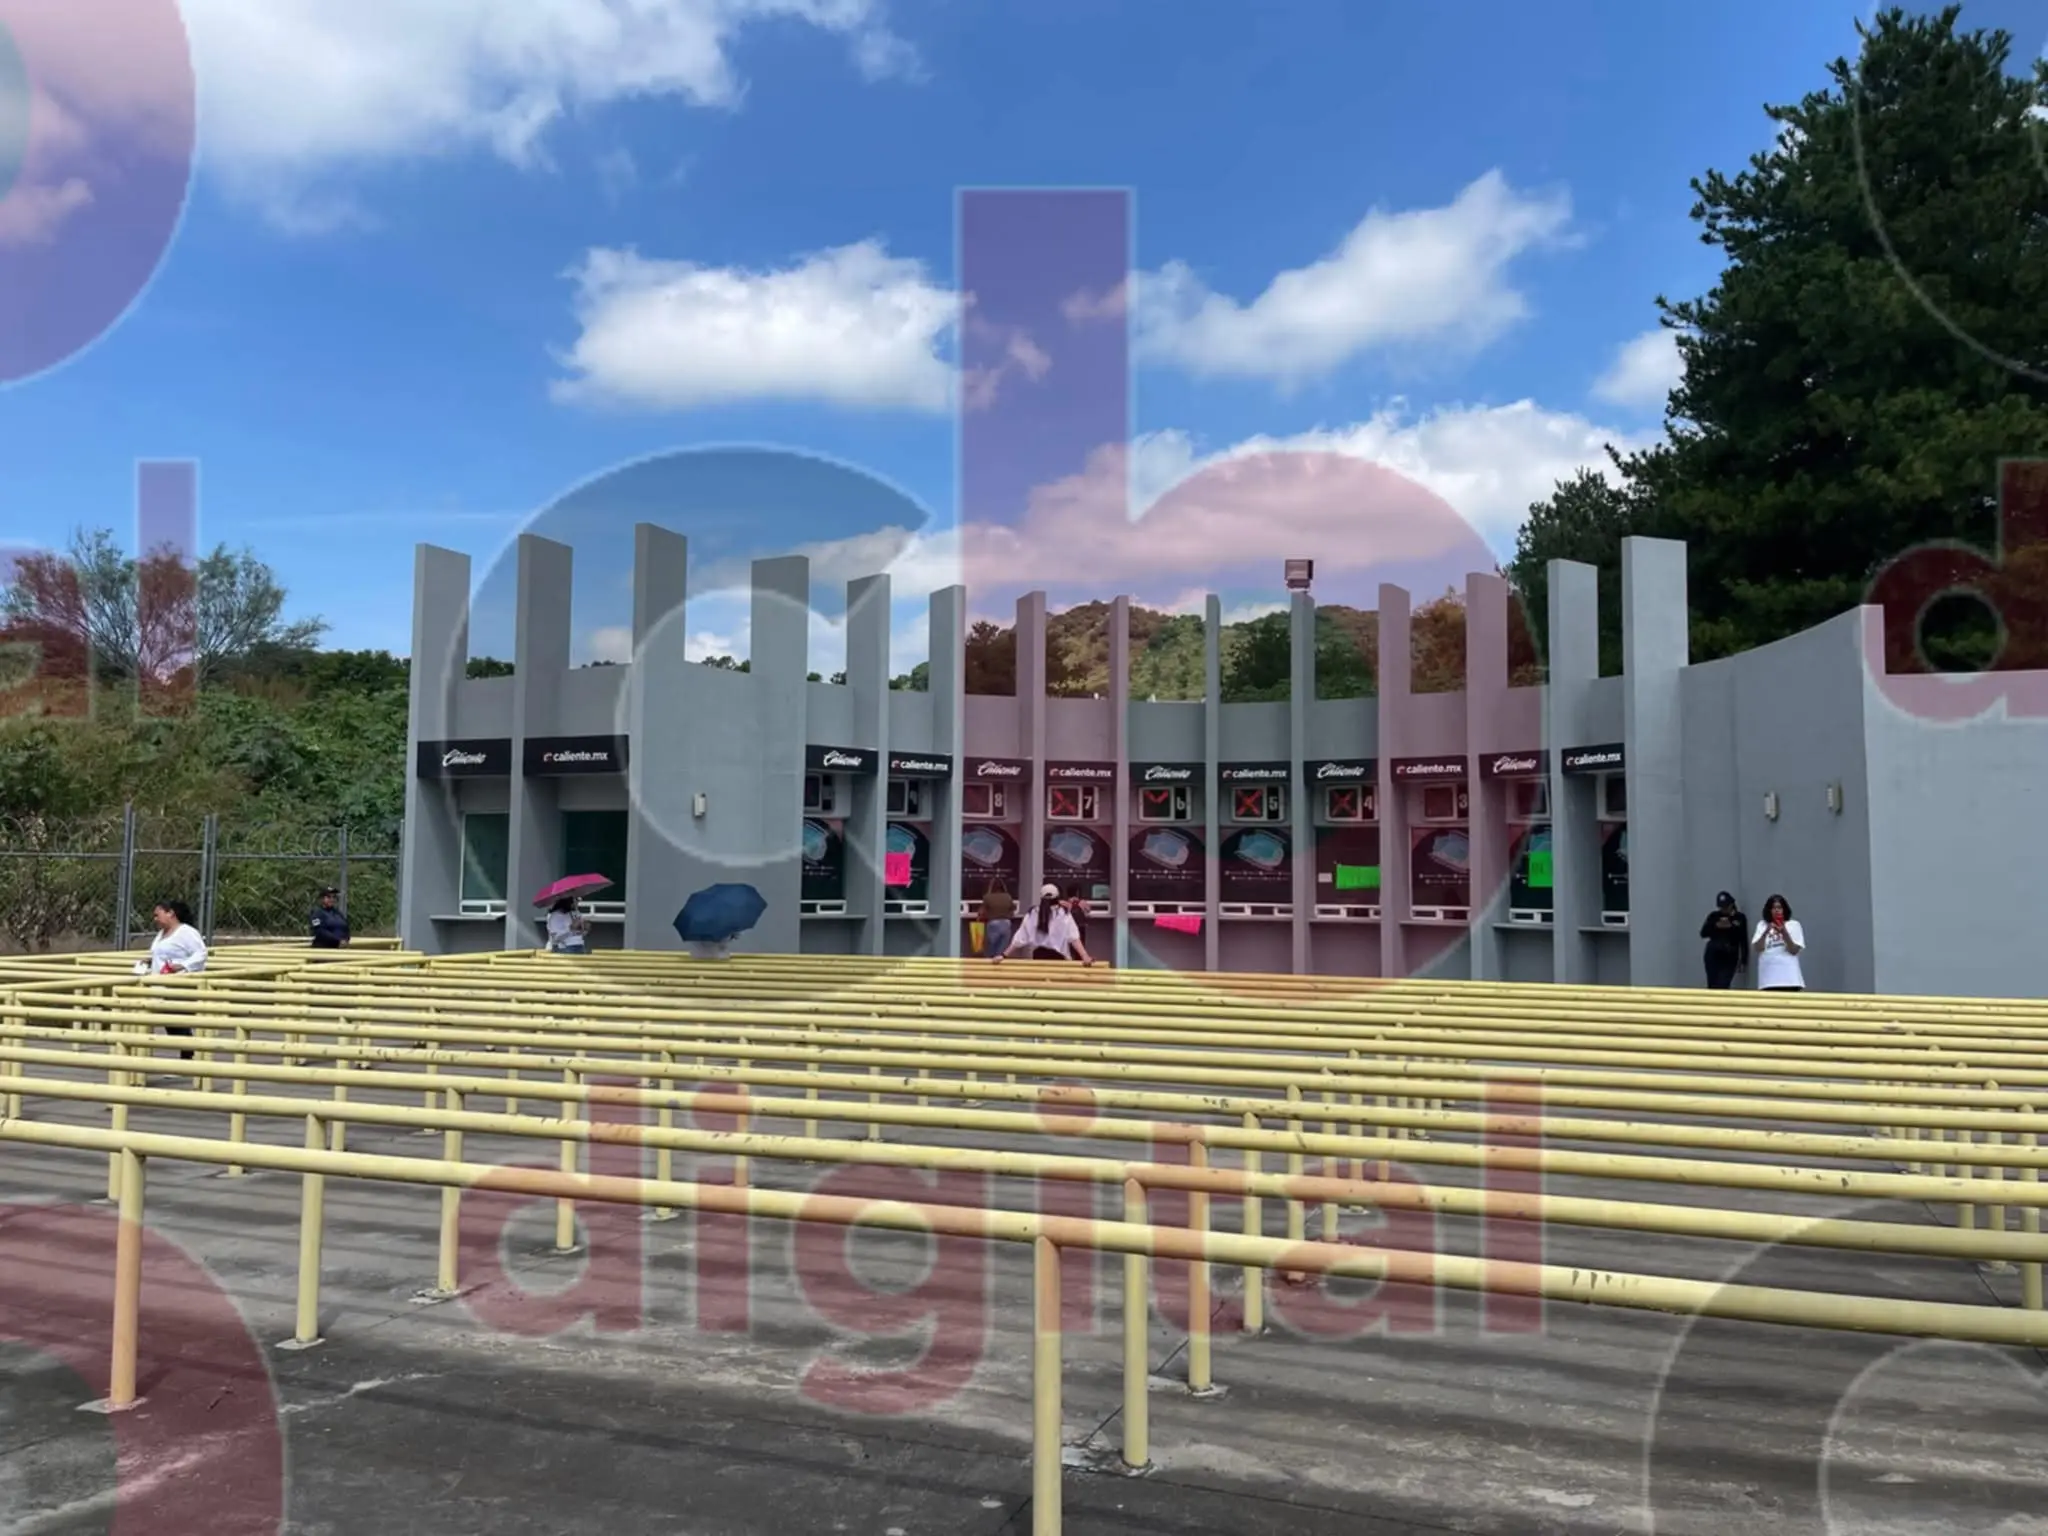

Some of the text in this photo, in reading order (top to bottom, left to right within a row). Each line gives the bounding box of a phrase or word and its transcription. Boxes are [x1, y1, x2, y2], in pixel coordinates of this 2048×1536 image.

[553, 751, 609, 762] caliente.mx
[1574, 752, 1622, 765] caliente.mx
[900, 760, 949, 771] caliente.mx
[1406, 764, 1463, 775] caliente.mx
[1060, 767, 1113, 778] caliente.mx
[1232, 769, 1287, 779] caliente.mx
[994, 793, 1003, 808] 8
[1084, 795, 1093, 811] 7
[1268, 796, 1278, 812] 5
[1363, 795, 1374, 811] 4
[1458, 793, 1468, 809] 3
